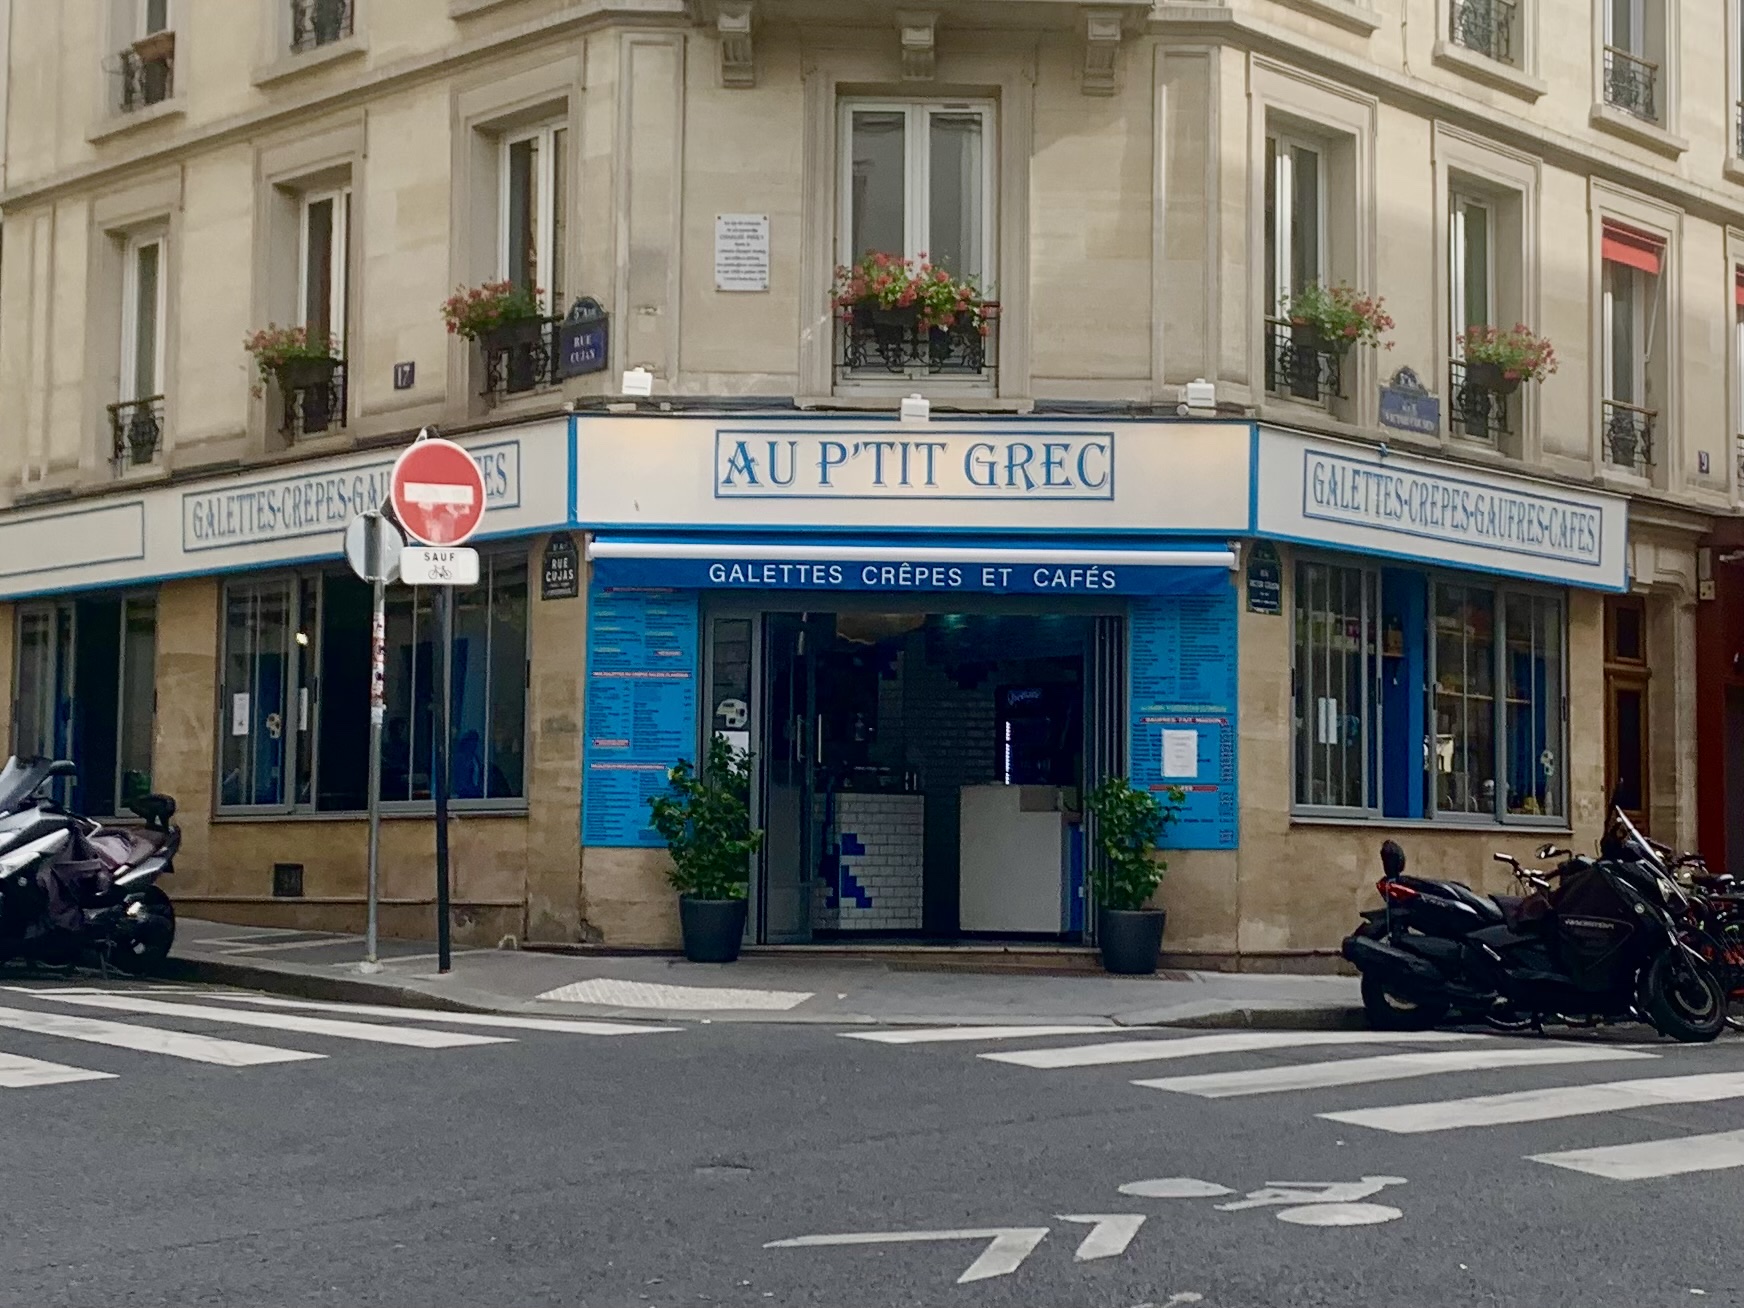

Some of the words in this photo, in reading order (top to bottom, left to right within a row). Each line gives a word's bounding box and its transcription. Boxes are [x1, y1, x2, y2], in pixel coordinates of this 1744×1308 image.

[573, 334, 592, 348] RUE
[397, 365, 411, 387] 17
[721, 440, 799, 487] AU
[816, 441, 947, 488] P'TIT
[964, 442, 1109, 492] GREC
[424, 552, 455, 562] SAUF
[551, 557, 569, 569] RUE
[545, 569, 574, 582] CUJAS
[709, 564, 843, 583] GALETTES
[862, 562, 962, 586] CRÊPES
[982, 568, 1012, 586] ET
[1033, 566, 1116, 588] CAFÉS
